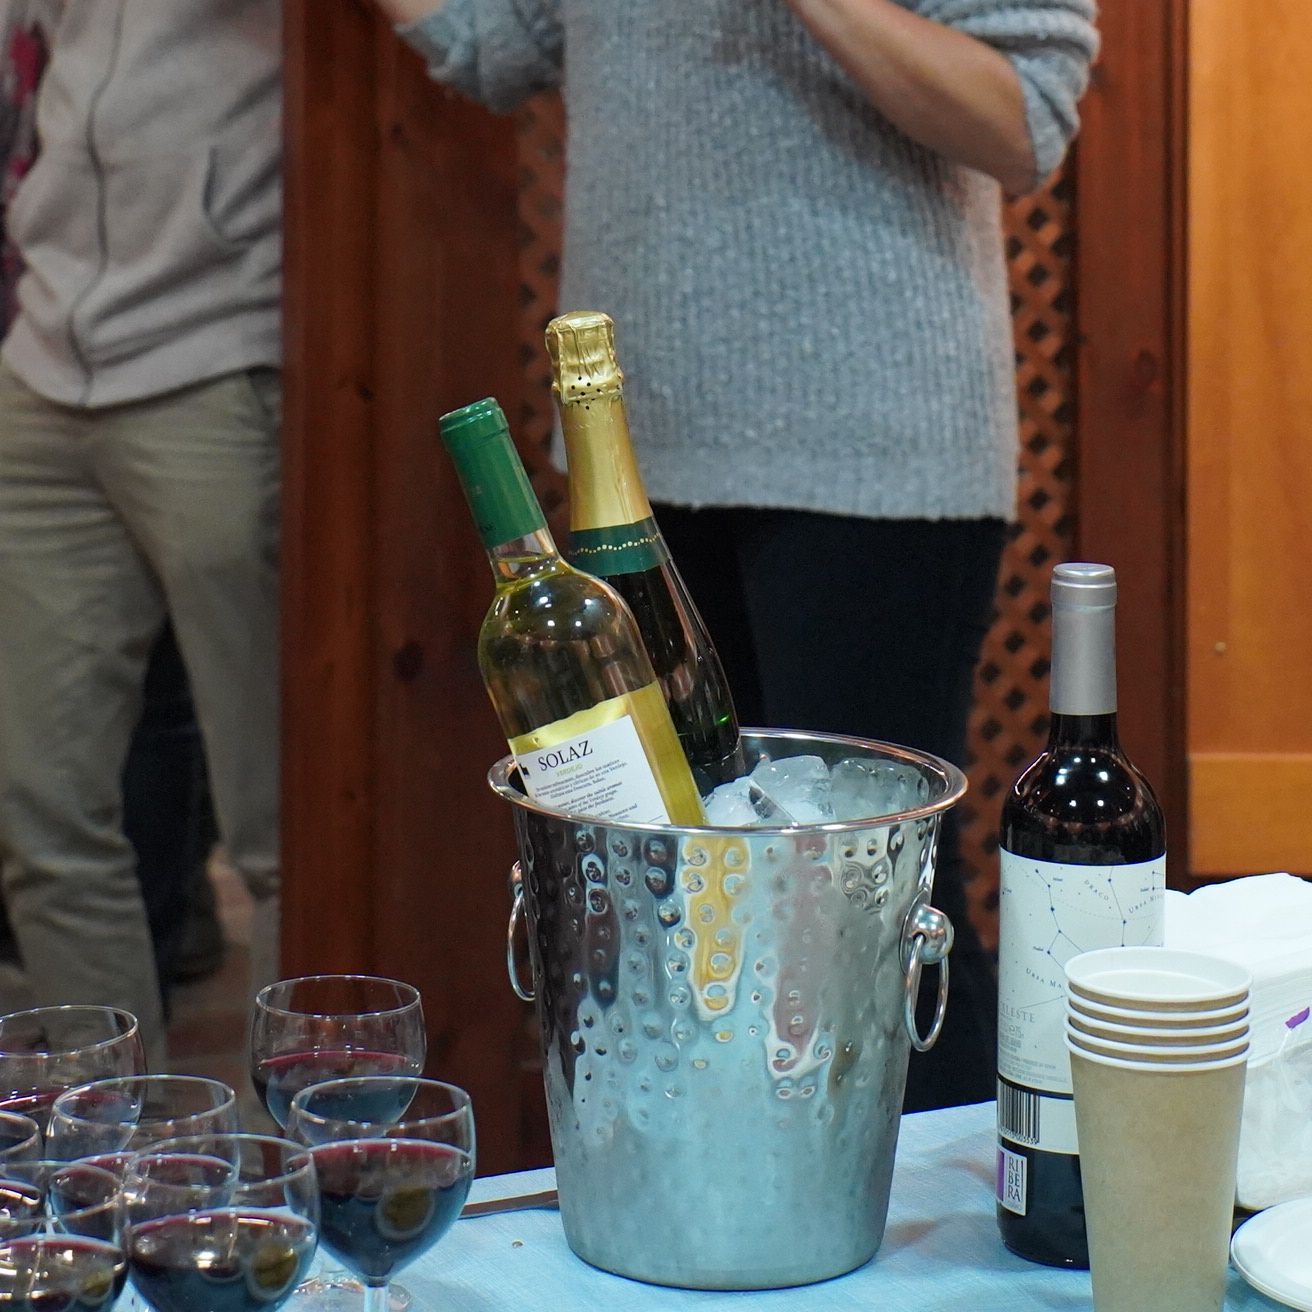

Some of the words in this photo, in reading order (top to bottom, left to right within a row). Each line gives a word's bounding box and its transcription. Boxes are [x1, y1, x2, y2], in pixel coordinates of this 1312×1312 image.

[538, 740, 593, 771] SOLAZ
[1083, 879, 1109, 901] DRACO
[1008, 1156, 1019, 1172] RI
[1008, 1170, 1021, 1188] BE
[1008, 1185, 1022, 1202] RA
